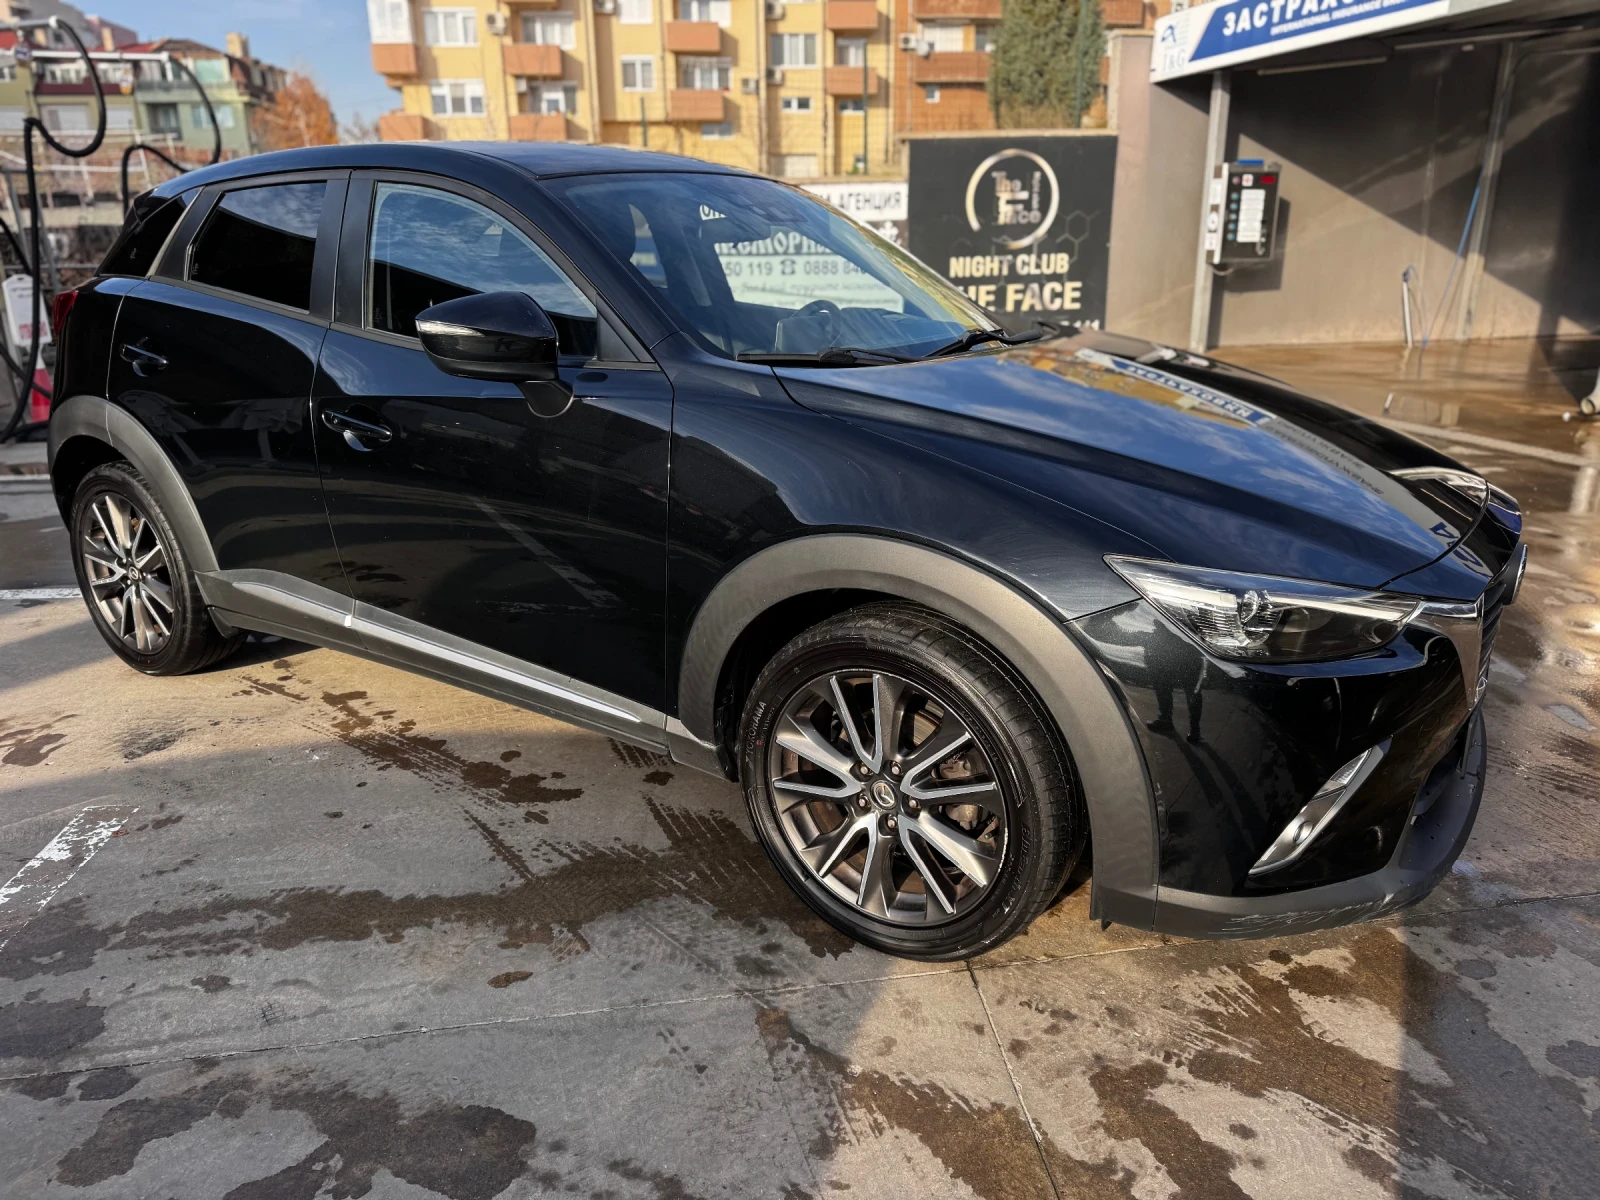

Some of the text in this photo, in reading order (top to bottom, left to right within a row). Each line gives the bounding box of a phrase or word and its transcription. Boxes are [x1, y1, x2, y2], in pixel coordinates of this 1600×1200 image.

[1223, 0, 1355, 36] ЗАСТРАХ
[748, 262, 773, 275] 119
[805, 260, 838, 275] 0888
[950, 253, 1070, 278] NIGHT CLUB
[1006, 281, 1082, 312] FACE
